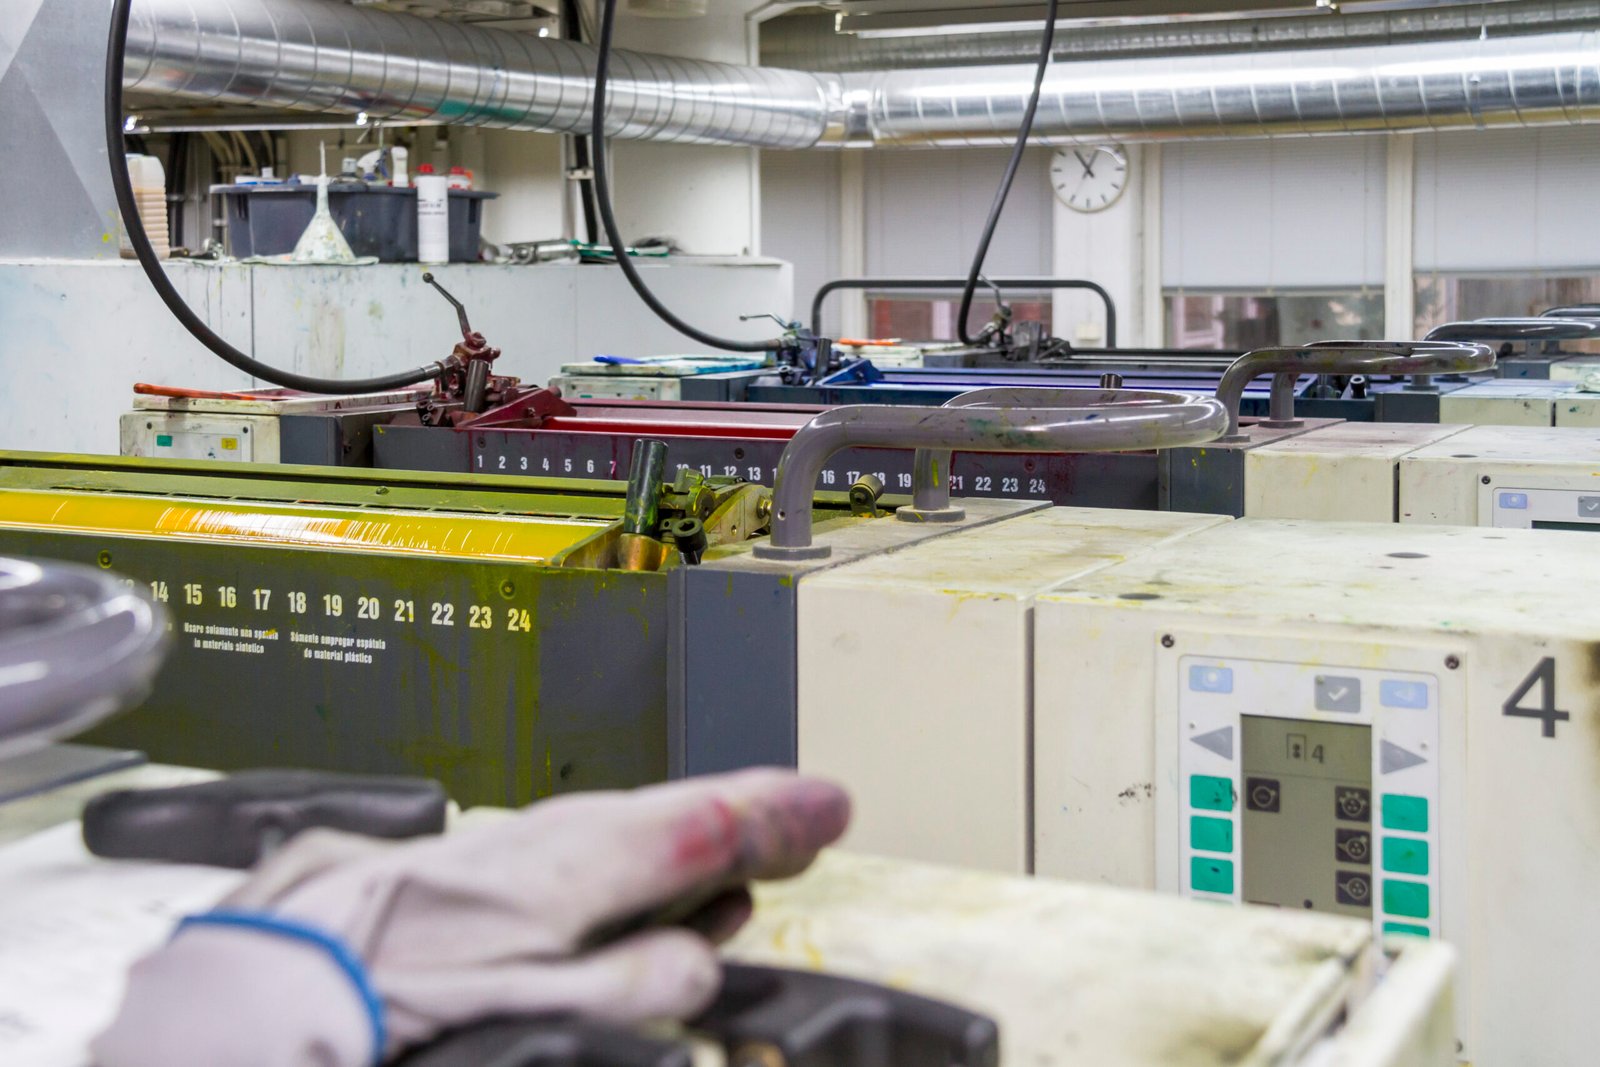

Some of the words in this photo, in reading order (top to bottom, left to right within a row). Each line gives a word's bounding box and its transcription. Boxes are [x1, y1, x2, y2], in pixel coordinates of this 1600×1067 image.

[477, 455, 483, 468] 1
[498, 456, 506, 469] 2
[520, 457, 528, 470] 3
[542, 458, 550, 471] 4
[564, 459, 572, 472] 5
[586, 460, 595, 473] 6
[609, 461, 617, 474] 7
[747, 467, 761, 480] 13
[821, 470, 835, 484] 16
[897, 473, 912, 487] 19
[975, 476, 992, 491] 22
[1002, 477, 1019, 492] 23
[1029, 478, 1046, 493] 24
[151, 581, 169, 602] 14
[184, 584, 203, 605] 15
[218, 586, 237, 608] 16
[252, 588, 271, 611] 17
[287, 591, 307, 614] 18
[322, 594, 343, 617] 19
[357, 597, 380, 620] 20
[394, 599, 415, 623] 21
[431, 602, 454, 626] 22
[469, 605, 492, 629] 23
[507, 608, 531, 632] 24
[184, 622, 204, 633] Usare
[320, 635, 355, 648] empregar
[303, 647, 313, 659] de
[314, 649, 343, 661] material
[1502, 656, 1569, 738] 4
[1312, 744, 1325, 764] 4
